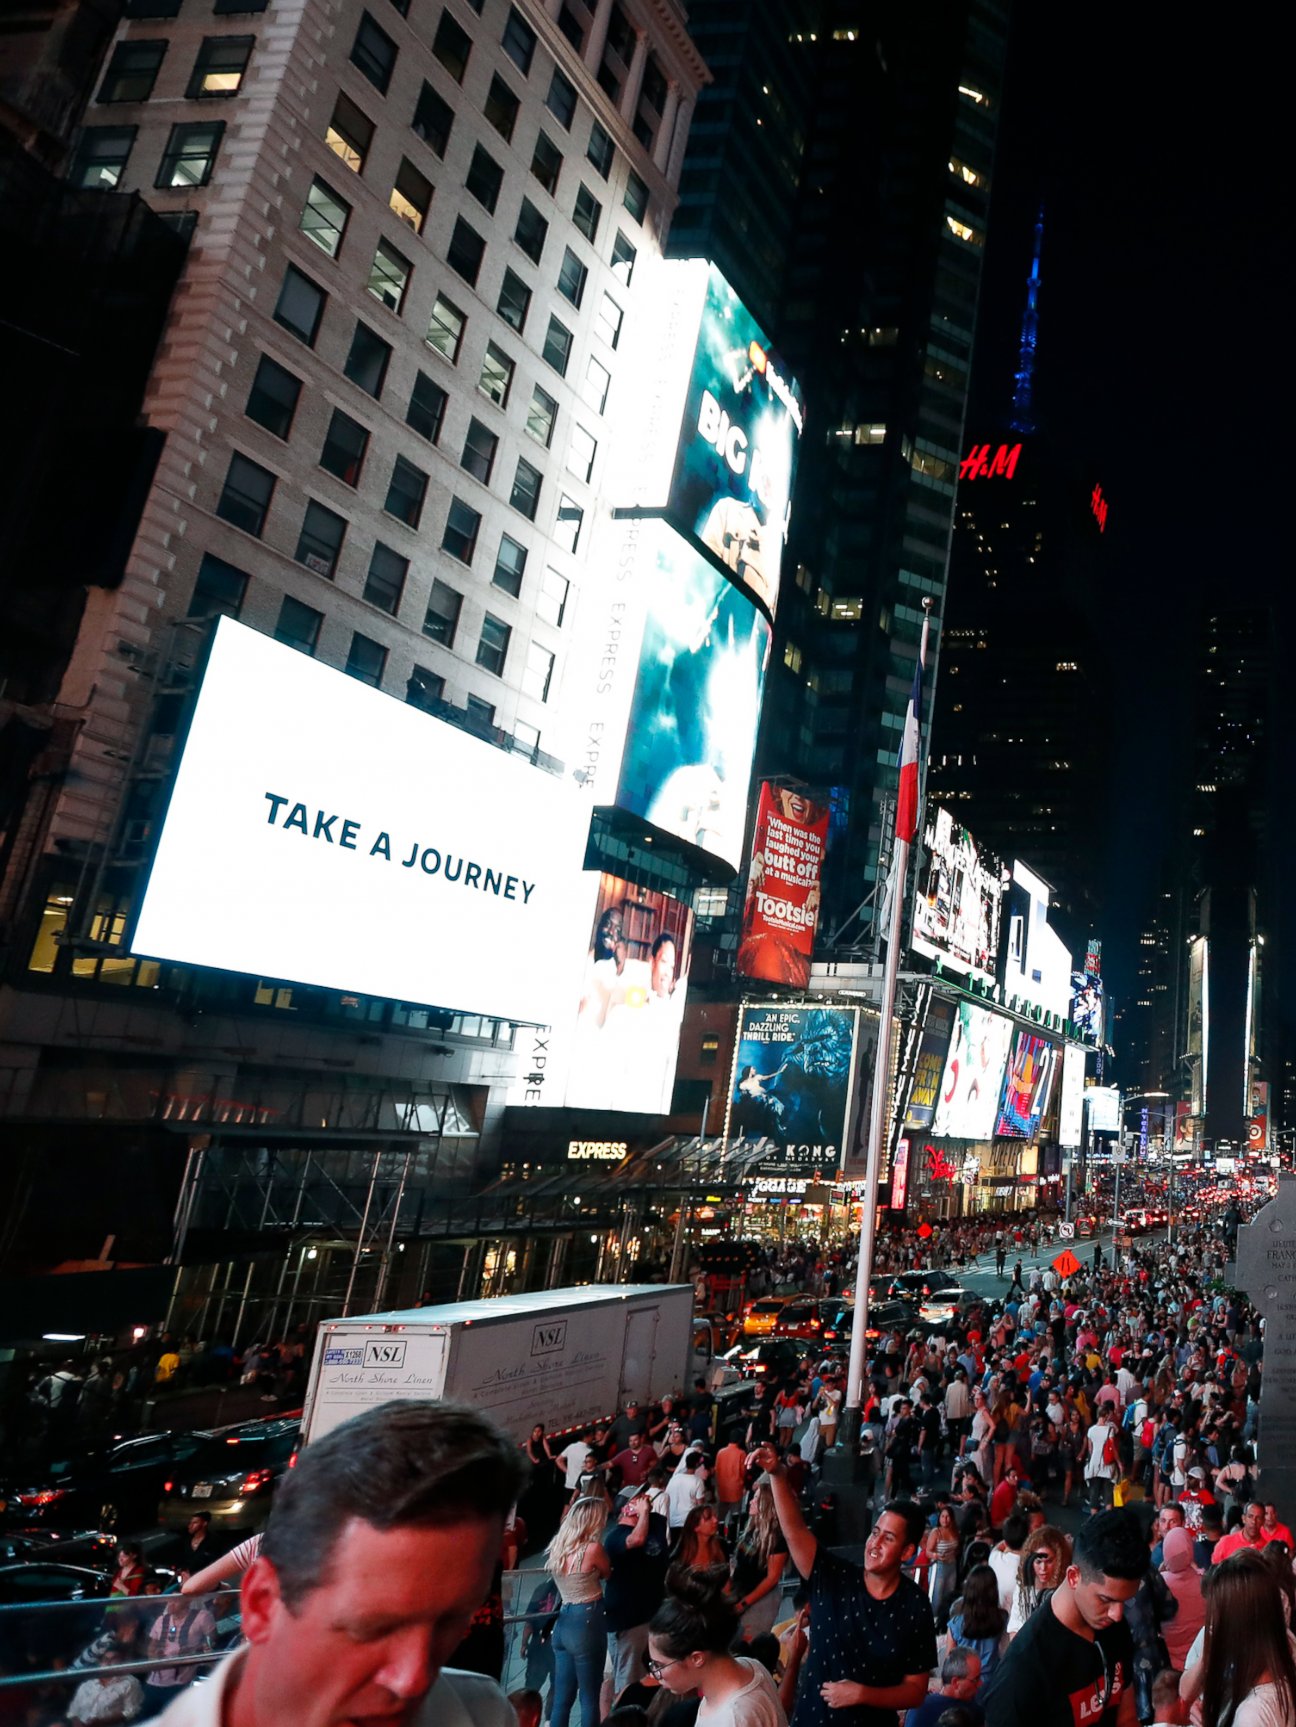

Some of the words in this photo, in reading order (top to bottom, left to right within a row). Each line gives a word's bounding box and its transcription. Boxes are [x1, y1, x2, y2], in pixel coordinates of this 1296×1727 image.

[698, 389, 749, 475] BIG
[958, 443, 1023, 481] H&M
[767, 825, 784, 840] last
[785, 831, 804, 848] time
[805, 841, 820, 855] you
[793, 827, 808, 839] was
[809, 829, 821, 845] the
[264, 791, 362, 851] TAKE
[368, 830, 392, 862] A
[401, 842, 536, 905] JOURNEY
[766, 836, 800, 857] laughed
[800, 849, 819, 864] your
[764, 847, 796, 874] butt
[797, 861, 819, 880] off
[765, 866, 774, 877] at
[755, 890, 815, 927] Tootsie
[743, 1032, 770, 1042] THRILL
[749, 1022, 789, 1032] DAZZLING
[522, 1025, 552, 1108] EXPRE
[910, 1086, 937, 1107] AWAY
[568, 1141, 627, 1159] EXPRESS
[786, 1144, 837, 1158] KONG
[535, 1327, 564, 1348] NSL
[367, 1346, 402, 1362] NSL
[329, 1372, 364, 1384] North
[367, 1372, 398, 1384] Shore
[403, 1372, 433, 1384] Linen
[482, 1363, 526, 1384] North
[530, 1358, 564, 1373] Shore
